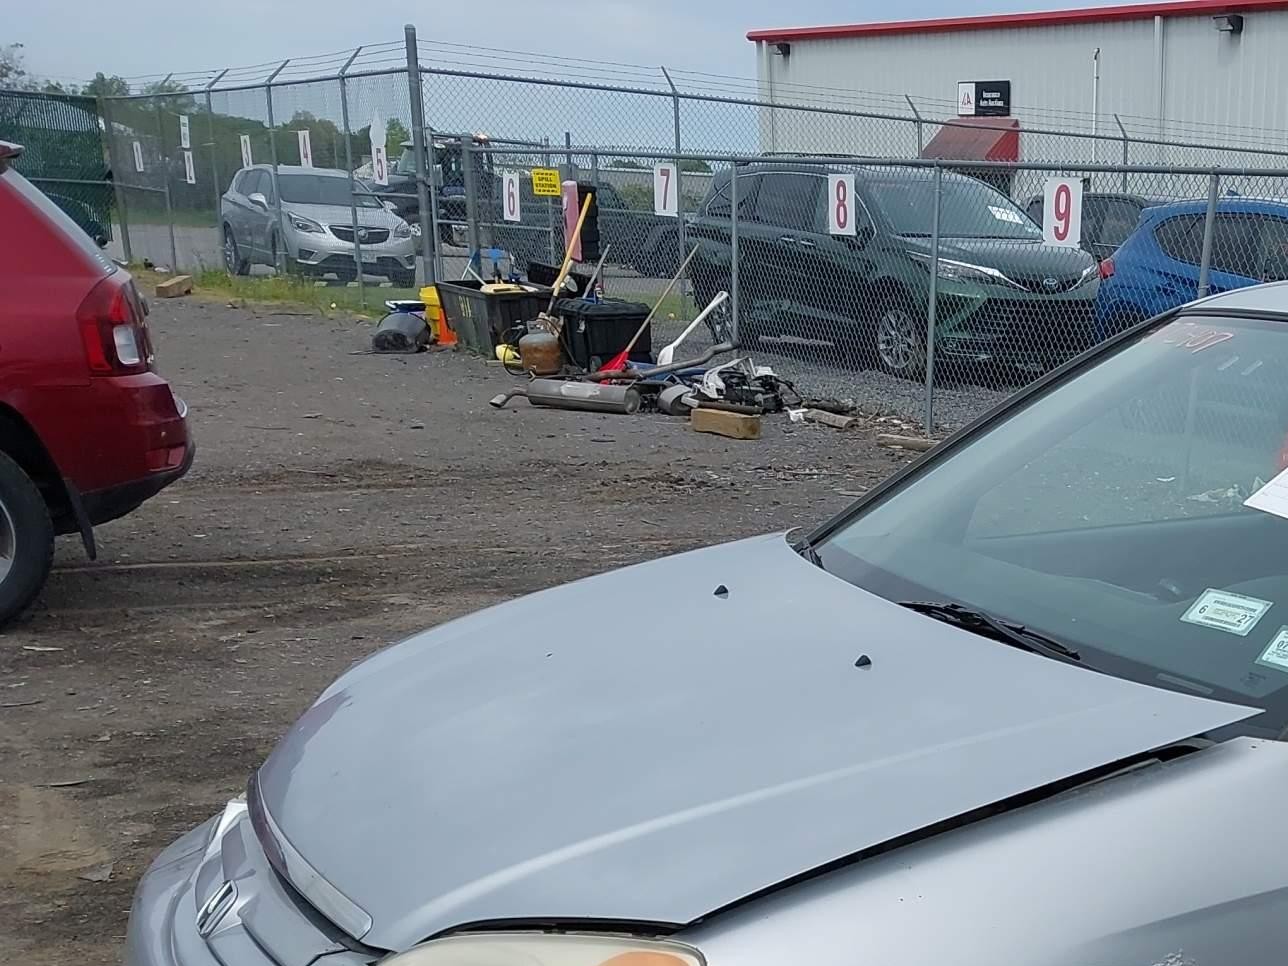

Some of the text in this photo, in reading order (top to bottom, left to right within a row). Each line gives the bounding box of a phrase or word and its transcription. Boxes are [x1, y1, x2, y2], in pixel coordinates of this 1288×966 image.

[242, 139, 250, 166] 3
[302, 134, 310, 160] 4
[375, 148, 384, 181] 5
[507, 178, 516, 216] 6
[659, 168, 671, 210] 7
[835, 180, 848, 229] 8
[1053, 184, 1072, 241] 9
[1198, 604, 1209, 615] 6
[1237, 614, 1255, 625] 27
